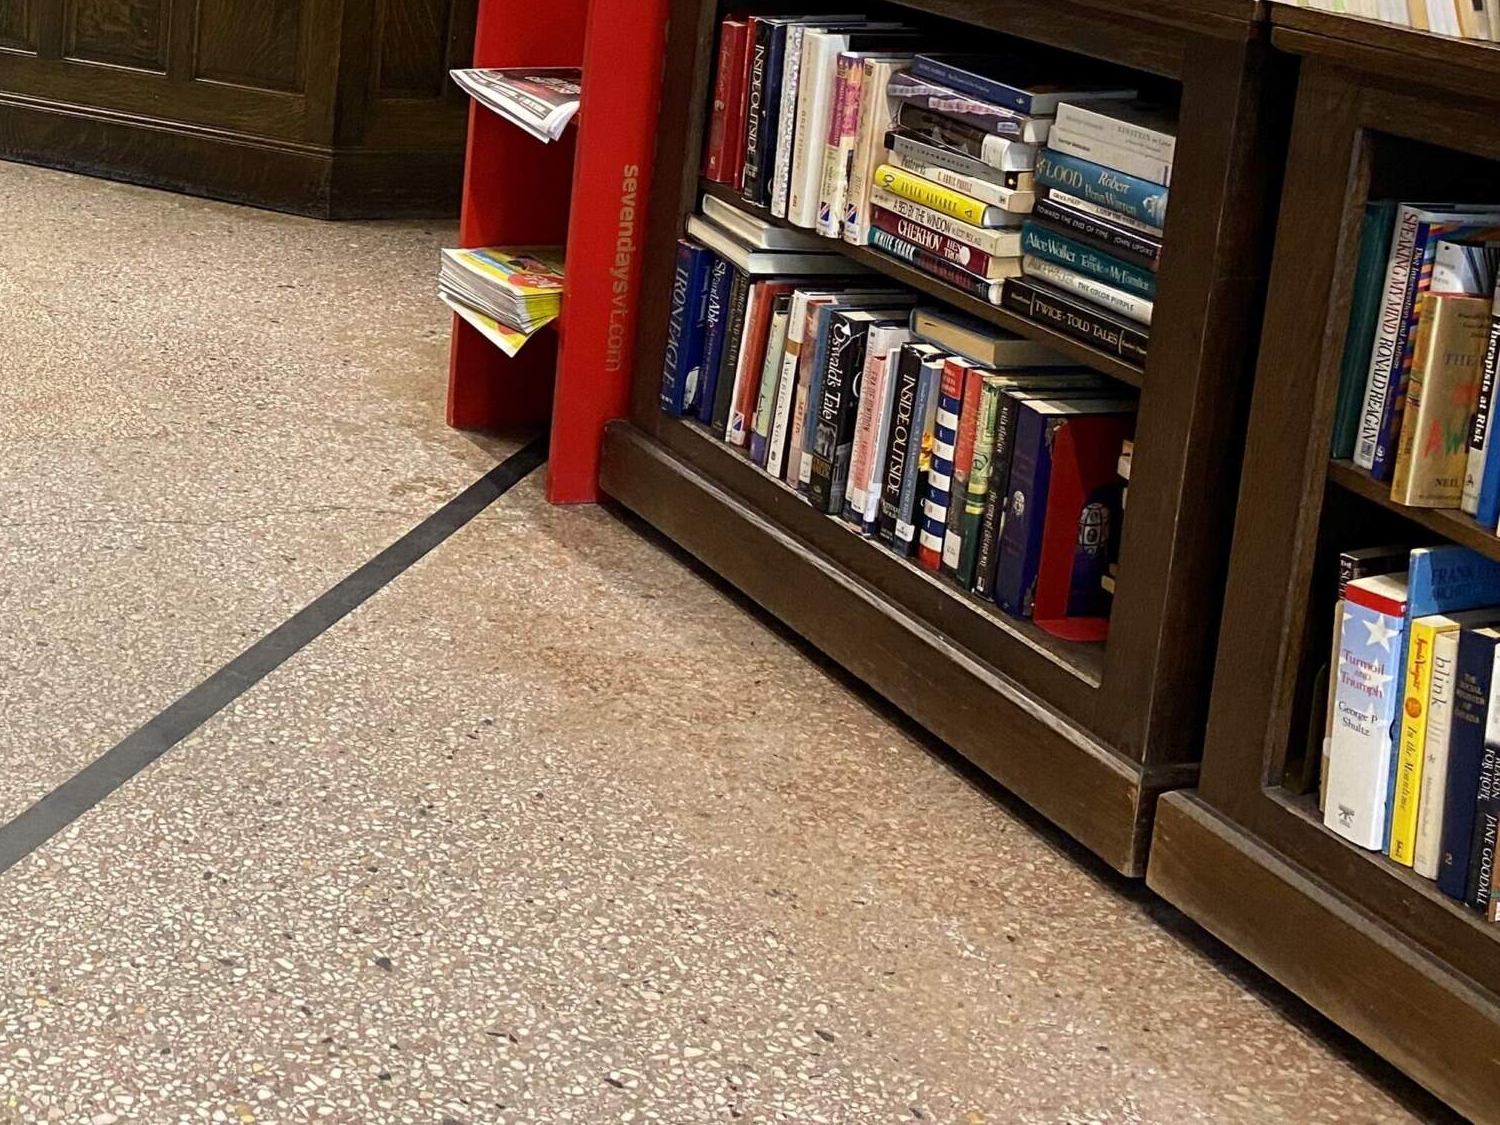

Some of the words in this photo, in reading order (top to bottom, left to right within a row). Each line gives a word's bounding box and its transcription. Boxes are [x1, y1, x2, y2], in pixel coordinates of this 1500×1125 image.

[900, 182, 922, 200] JULIA
[926, 191, 958, 213] ALVAREZ
[1097, 171, 1131, 194] Robert
[1104, 190, 1137, 215] Warren
[897, 219, 942, 251] CHEKHOV
[915, 207, 925, 224] THE
[926, 209, 952, 233] WINDOW
[1036, 204, 1060, 220] TOWARD
[1060, 213, 1073, 223] THE
[1073, 218, 1084, 231] END
[1085, 224, 1095, 233] OF
[1095, 227, 1110, 239] TIME
[1113, 235, 1131, 248] JOHN
[894, 235, 916, 261] SHARK
[1025, 232, 1049, 252] Alice
[1048, 237, 1077, 263] Walker
[1391, 211, 1418, 273] SPEAKING
[711, 259, 726, 281] Sly
[1080, 254, 1105, 274] Temple
[1109, 265, 1122, 284] My
[1121, 270, 1150, 291] Familiar
[1389, 273, 1406, 293] MY
[671, 266, 689, 319] IRON
[1077, 281, 1089, 292] THE
[1089, 285, 1111, 302] COLOR
[1110, 295, 1135, 312] PURPLE
[1404, 266, 1419, 320] Intervention
[707, 294, 721, 328] Able
[1382, 291, 1403, 334] MIND
[1092, 325, 1118, 345] TALES
[1398, 320, 1407, 338] and
[663, 319, 682, 388] EAGLE
[826, 322, 846, 388] Oswald's
[1371, 338, 1394, 392] RONALD
[1443, 354, 1474, 367] THE
[1483, 322, 1500, 391] Therapists
[776, 361, 793, 419] AMERICAN
[822, 389, 841, 421] Tale
[1479, 392, 1487, 408] at
[1361, 389, 1385, 443] REAGAN
[1473, 411, 1486, 443] Risk
[770, 423, 782, 445] SON
[1343, 648, 1385, 677] Turmoil
[1340, 670, 1383, 700] Triumph
[1432, 655, 1451, 706] blink
[1338, 700, 1370, 725] George
[1342, 715, 1371, 737] Shultz
[1408, 739, 1416, 756] the
[1410, 725, 1418, 739] In
[1483, 747, 1496, 770] FOR
[1400, 758, 1414, 812] Meantime
[1477, 771, 1492, 802] HOPE
[1482, 813, 1498, 845] JANE
[1445, 852, 1453, 866] 2
[1476, 846, 1494, 906] GOODALL
